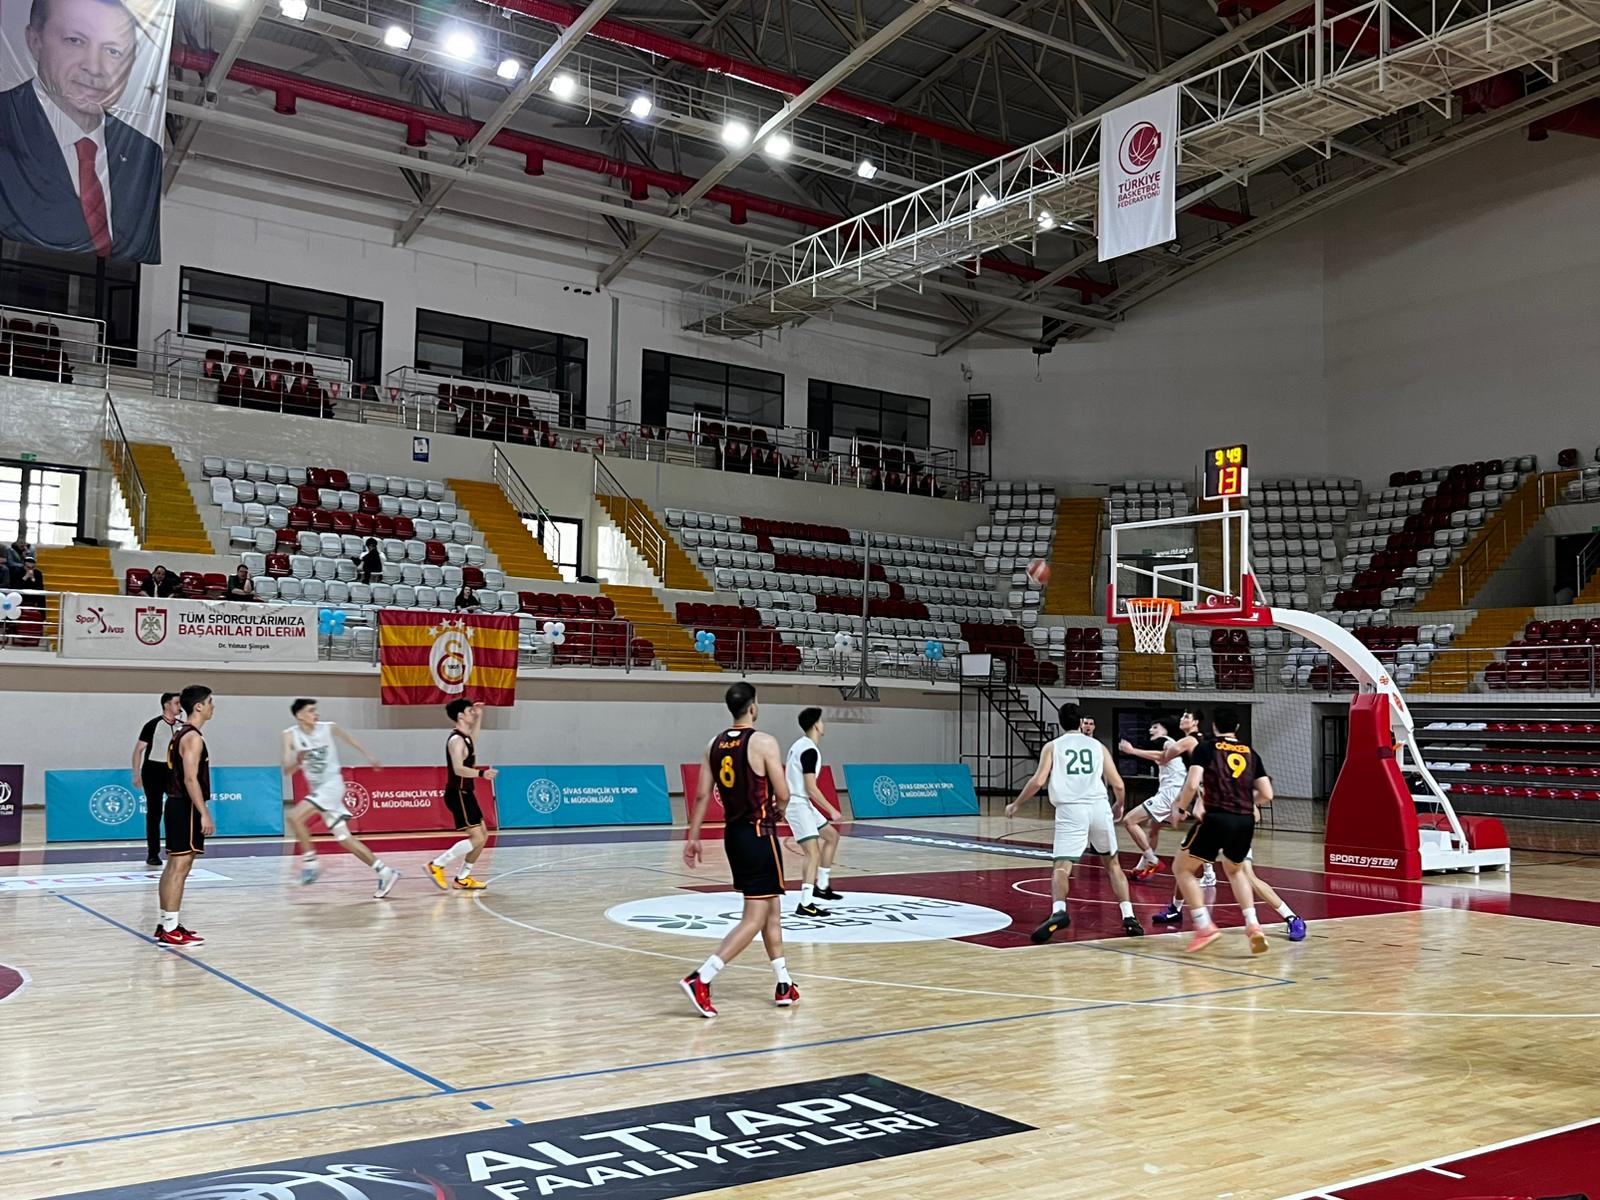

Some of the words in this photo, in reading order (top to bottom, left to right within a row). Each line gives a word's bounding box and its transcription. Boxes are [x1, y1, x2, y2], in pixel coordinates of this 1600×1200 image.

[1118, 171, 1160, 193] TÜRKİYE
[1117, 190, 1161, 208] FEDERASYONU
[1118, 183, 1160, 201] BASKETBOL
[1218, 466, 1238, 494] 13
[76, 614, 95, 624] Spor
[179, 612, 205, 623] TÜM
[208, 614, 305, 626] SPORCULARIMIZA
[178, 624, 252, 638] BAŞARILAR
[1065, 748, 1093, 775] 29
[1227, 753, 1247, 778] 9
[372, 790, 394, 799] SİVAS
[395, 789, 428, 800] GENÇLİK
[562, 787, 582, 795] SİVAS
[381, 799, 431, 809] MÜDÜRLÜĞÜ
[1329, 853, 1398, 867] SPORTSYSTEM
[465, 1093, 897, 1182] ALTYAPI
[484, 1110, 940, 1200] FAALİYETLERİ
